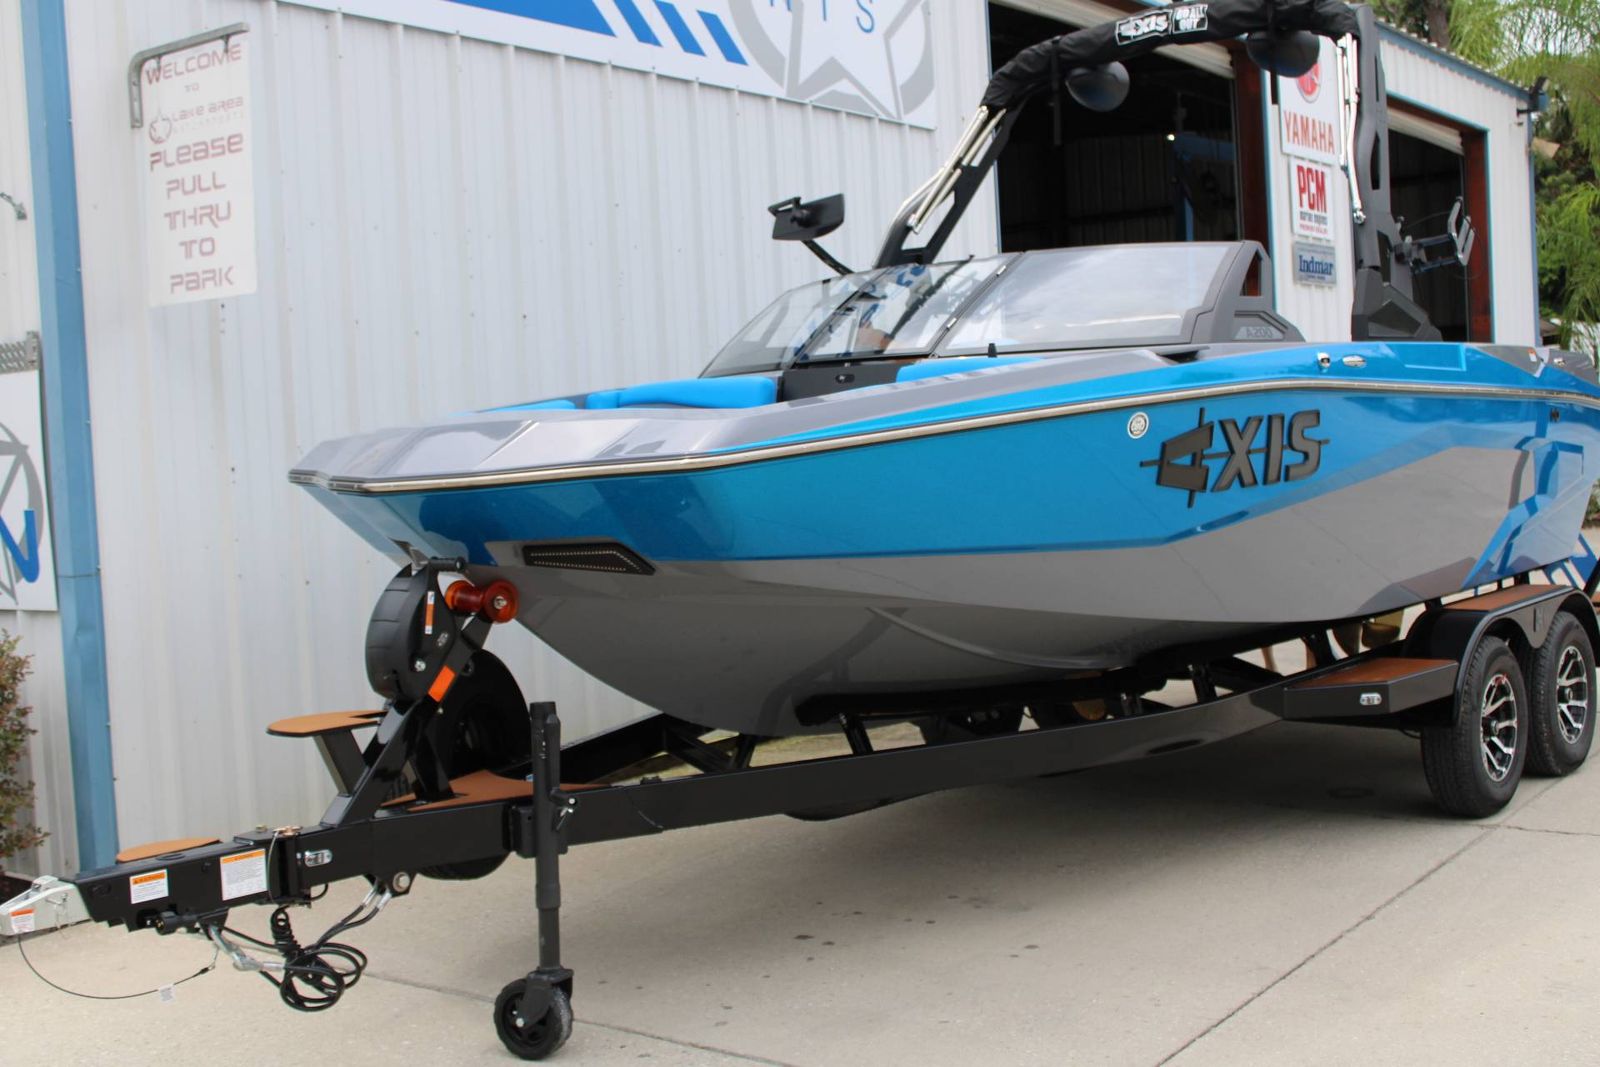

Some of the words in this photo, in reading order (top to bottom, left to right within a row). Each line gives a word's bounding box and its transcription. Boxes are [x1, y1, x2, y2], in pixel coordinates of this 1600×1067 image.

[145, 43, 242, 85] WELCOME
[1283, 110, 1335, 154] YAMAHA
[166, 171, 227, 199] PULL
[1297, 164, 1327, 213] PCM
[164, 201, 231, 230] THRU
[179, 236, 216, 260] TO
[1298, 255, 1334, 276] Indmar
[1148, 408, 1326, 500] AXIS
